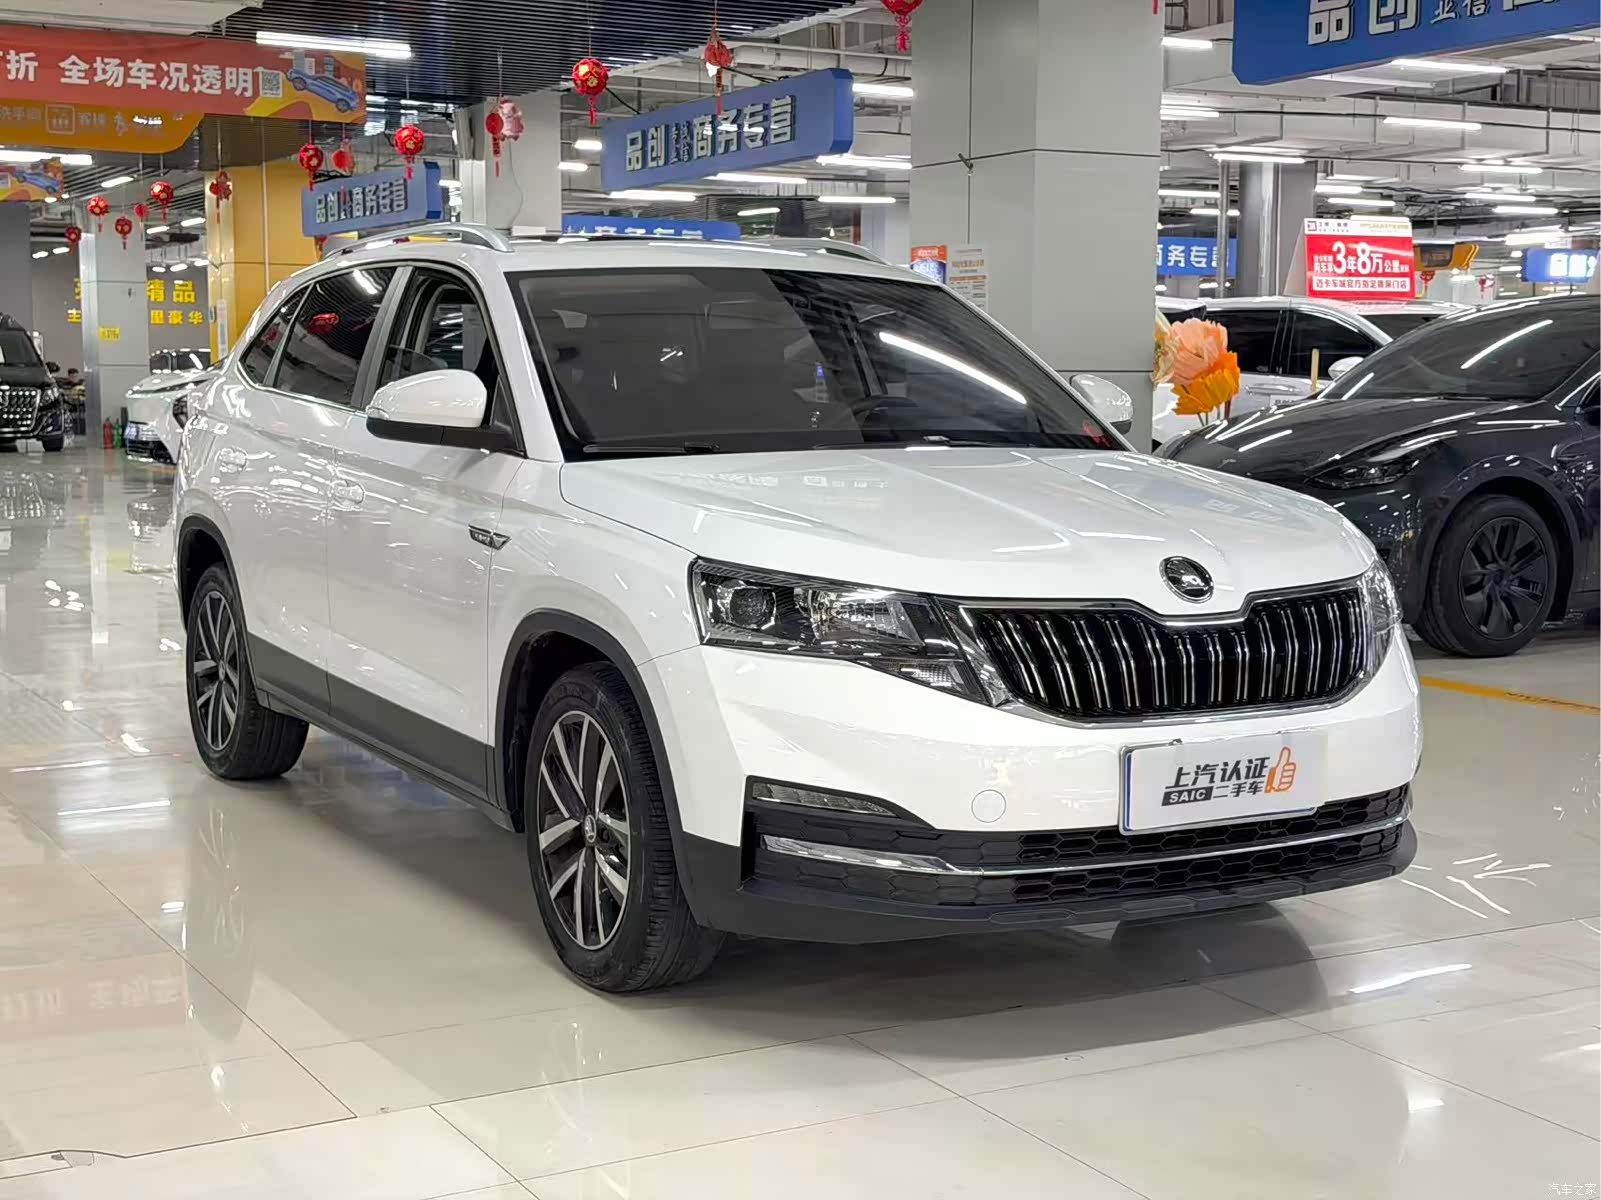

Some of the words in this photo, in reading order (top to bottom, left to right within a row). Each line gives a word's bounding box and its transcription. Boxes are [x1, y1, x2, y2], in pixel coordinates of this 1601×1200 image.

[0, 50, 39, 82] 折
[58, 54, 254, 98] 全场车况透明
[626, 124, 667, 172] 品创
[693, 95, 794, 160] 商务专营
[1165, 756, 1271, 790] 上汽认证
[1168, 788, 1207, 804] SAIC
[1213, 780, 1265, 799] 二手车
